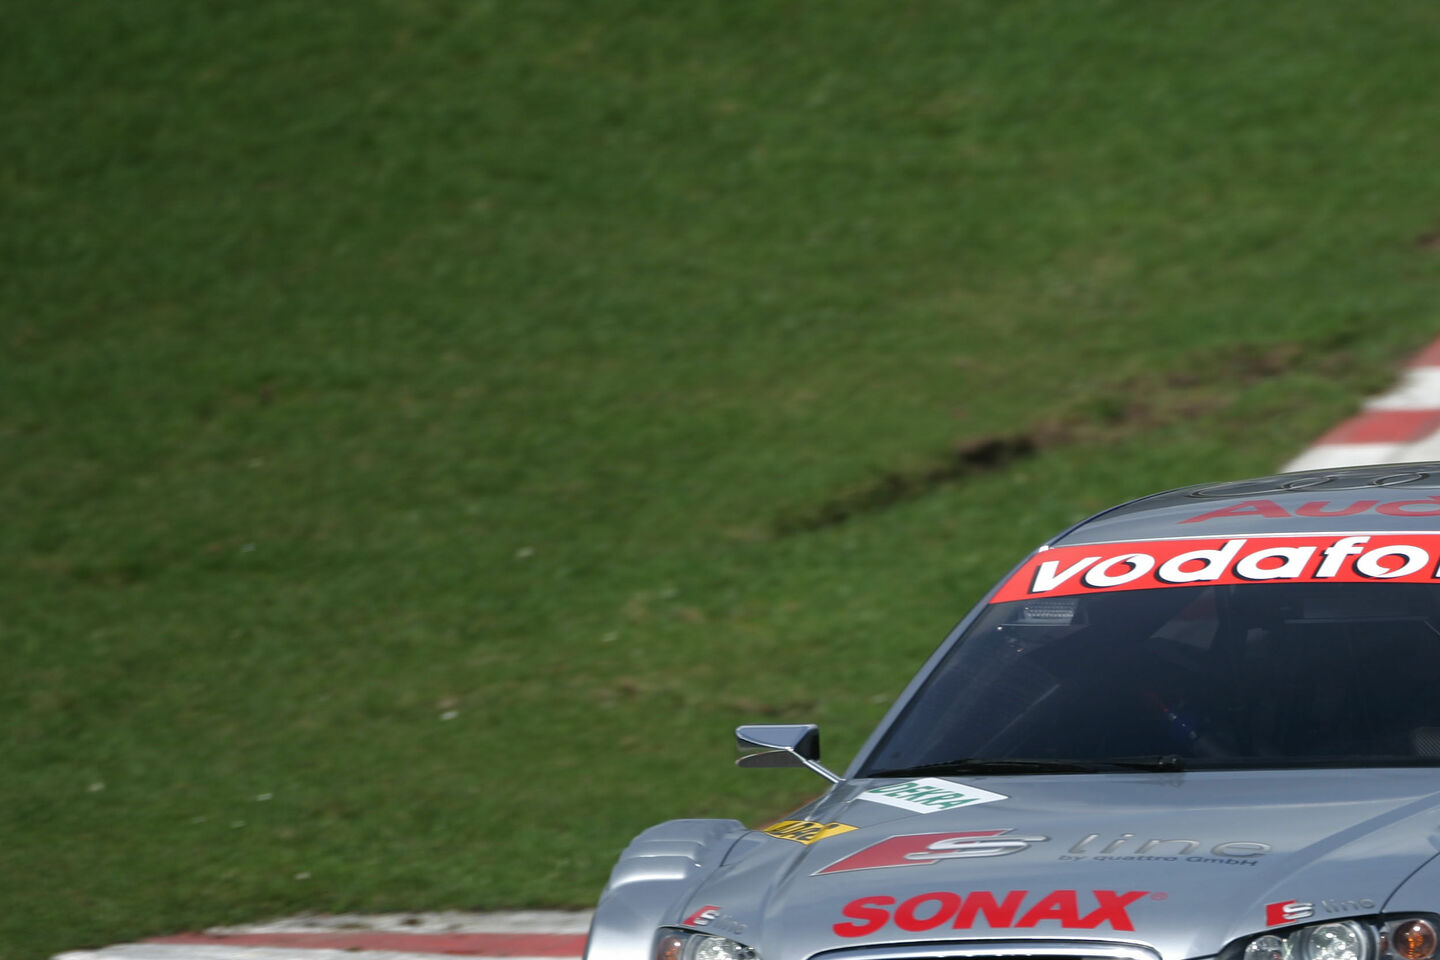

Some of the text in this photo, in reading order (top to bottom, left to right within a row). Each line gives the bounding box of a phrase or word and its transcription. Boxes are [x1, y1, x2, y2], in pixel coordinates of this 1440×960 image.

[867, 782, 978, 811] DEKRA
[1067, 833, 1273, 858] line
[1093, 854, 1178, 863] quattro
[1186, 856, 1259, 867] GmbH
[832, 890, 1151, 938] SONAX
